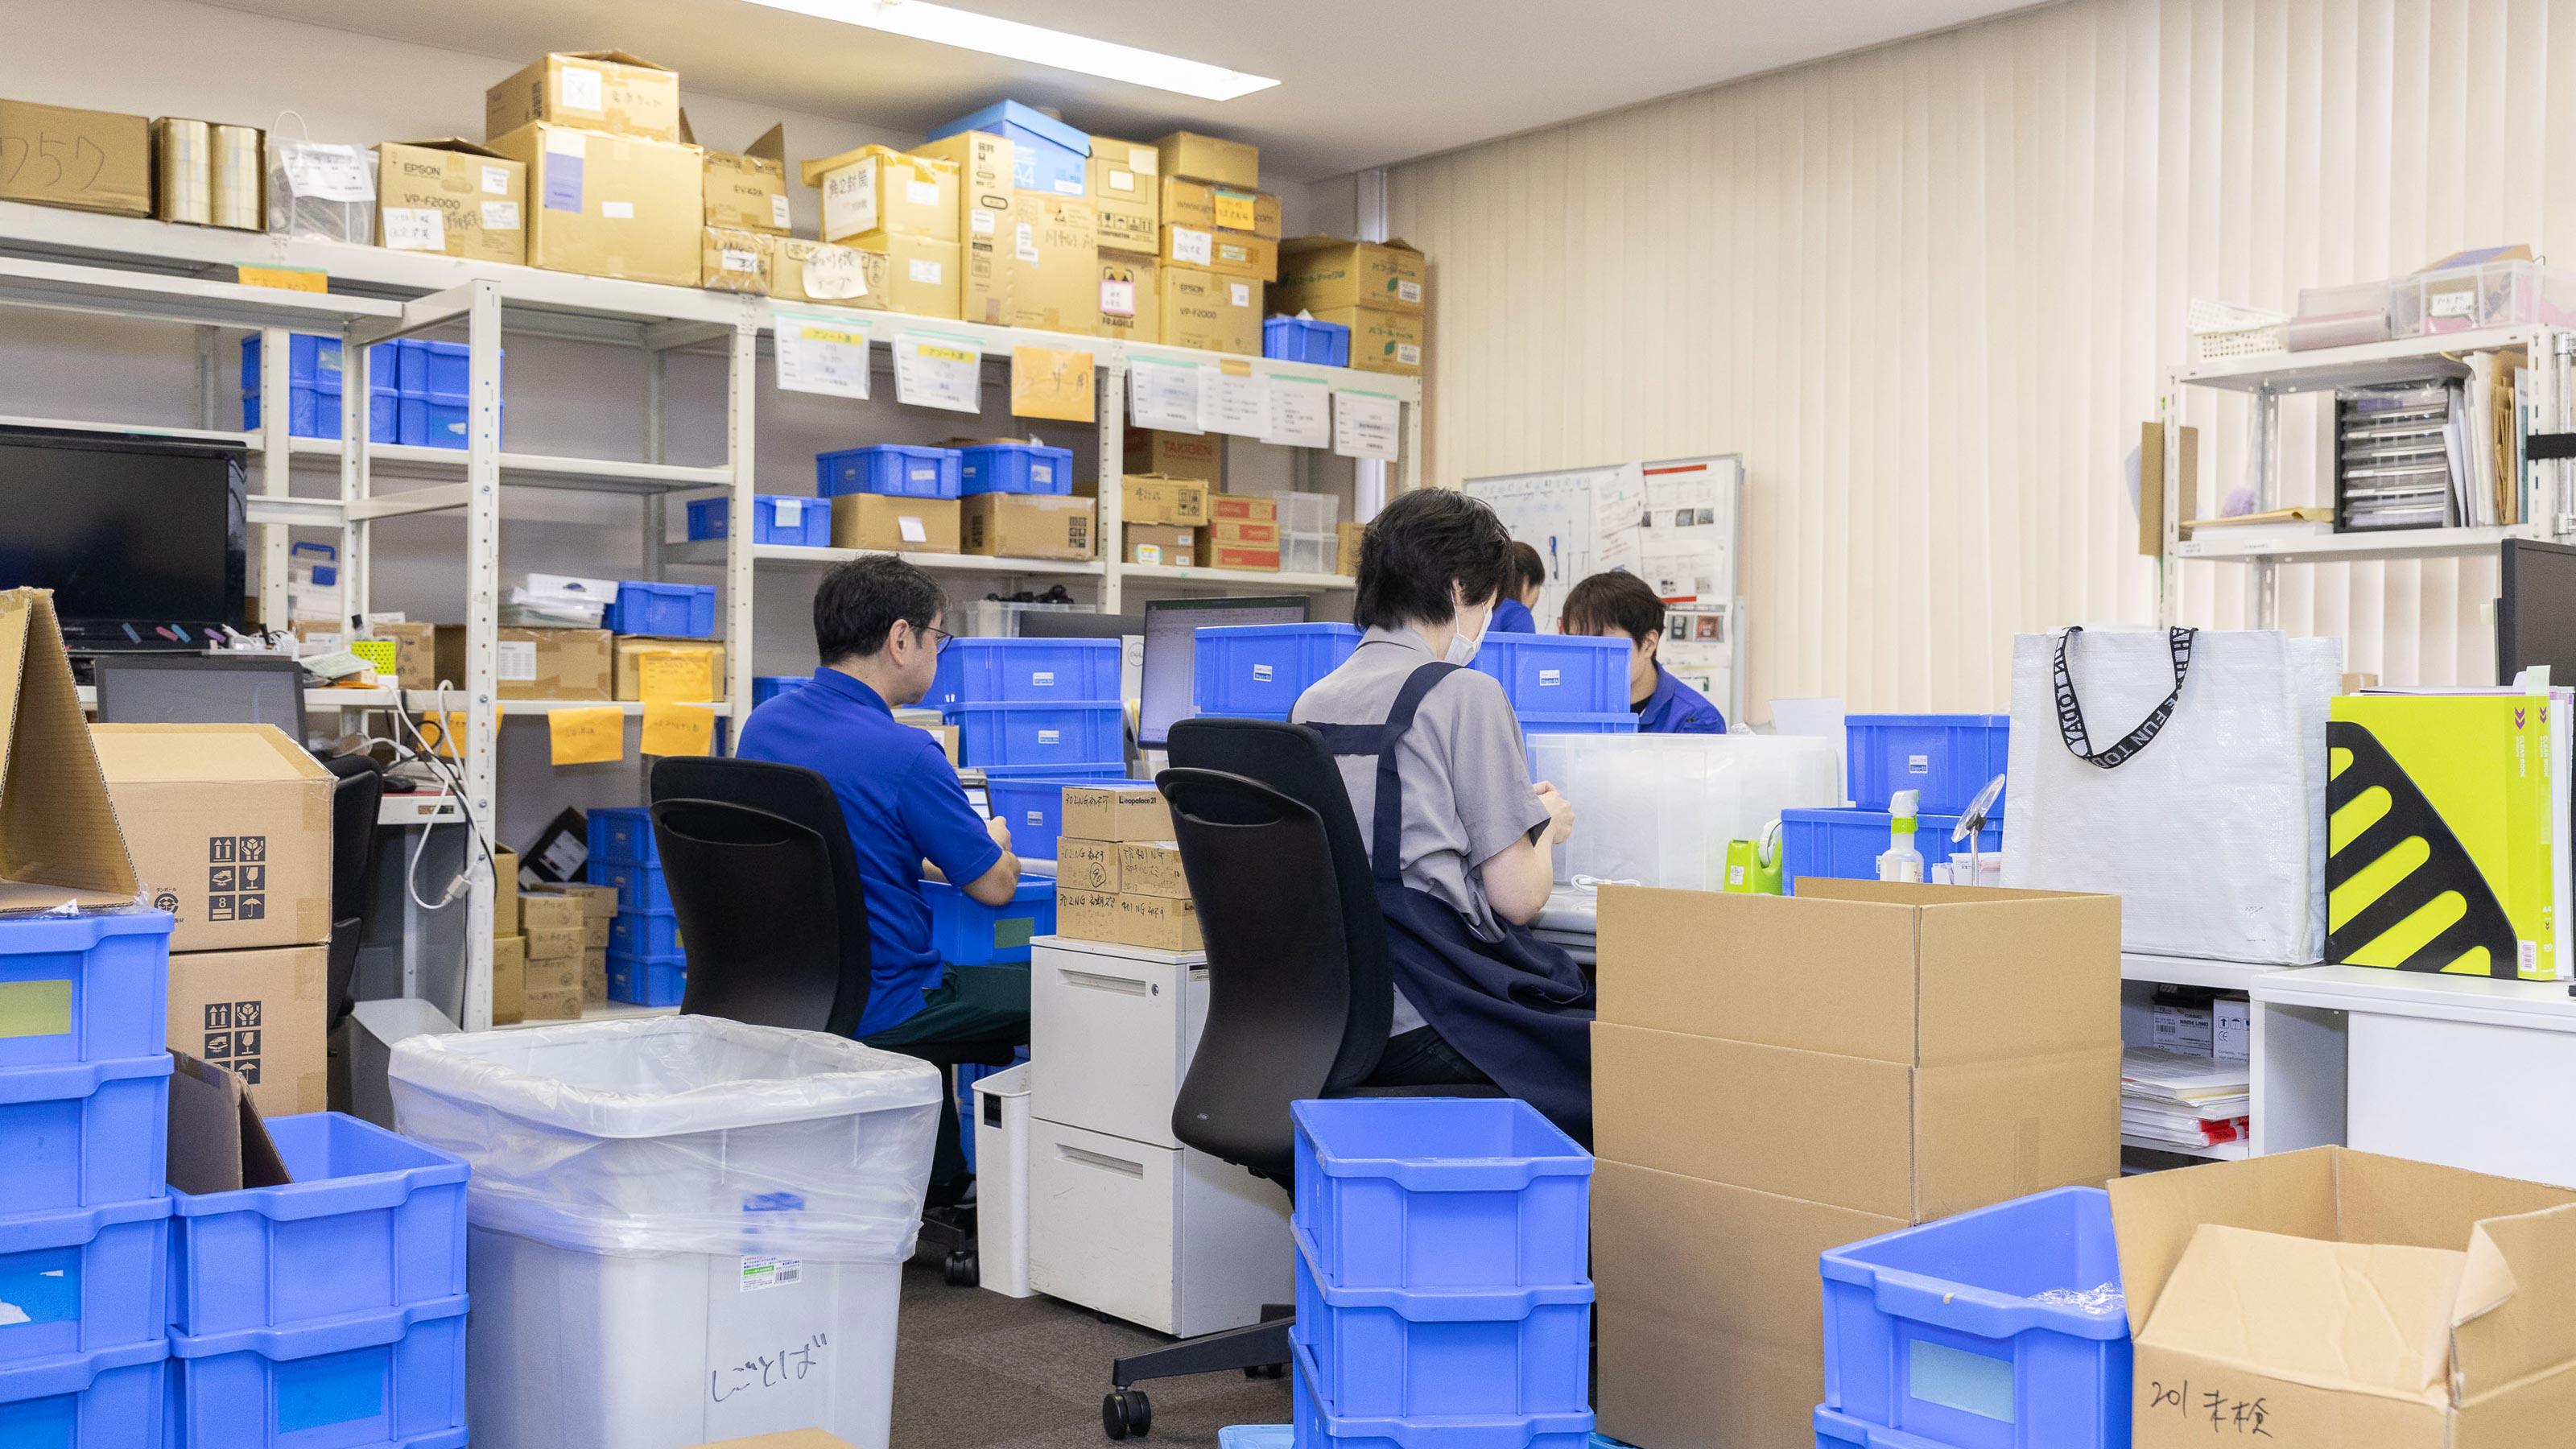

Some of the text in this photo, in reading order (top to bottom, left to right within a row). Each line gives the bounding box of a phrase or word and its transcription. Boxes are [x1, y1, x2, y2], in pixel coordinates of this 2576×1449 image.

[403, 163, 441, 175] EPSON
[404, 194, 461, 208] VP-F2000
[1179, 283, 1204, 293] EPSON
[1179, 308, 1217, 320] VP-F2000
[1102, 316, 1135, 328] FRAGILE
[2129, 710, 2168, 746] FUN
[712, 1332, 828, 1403] しごとば
[2151, 1379, 2187, 1419] 201
